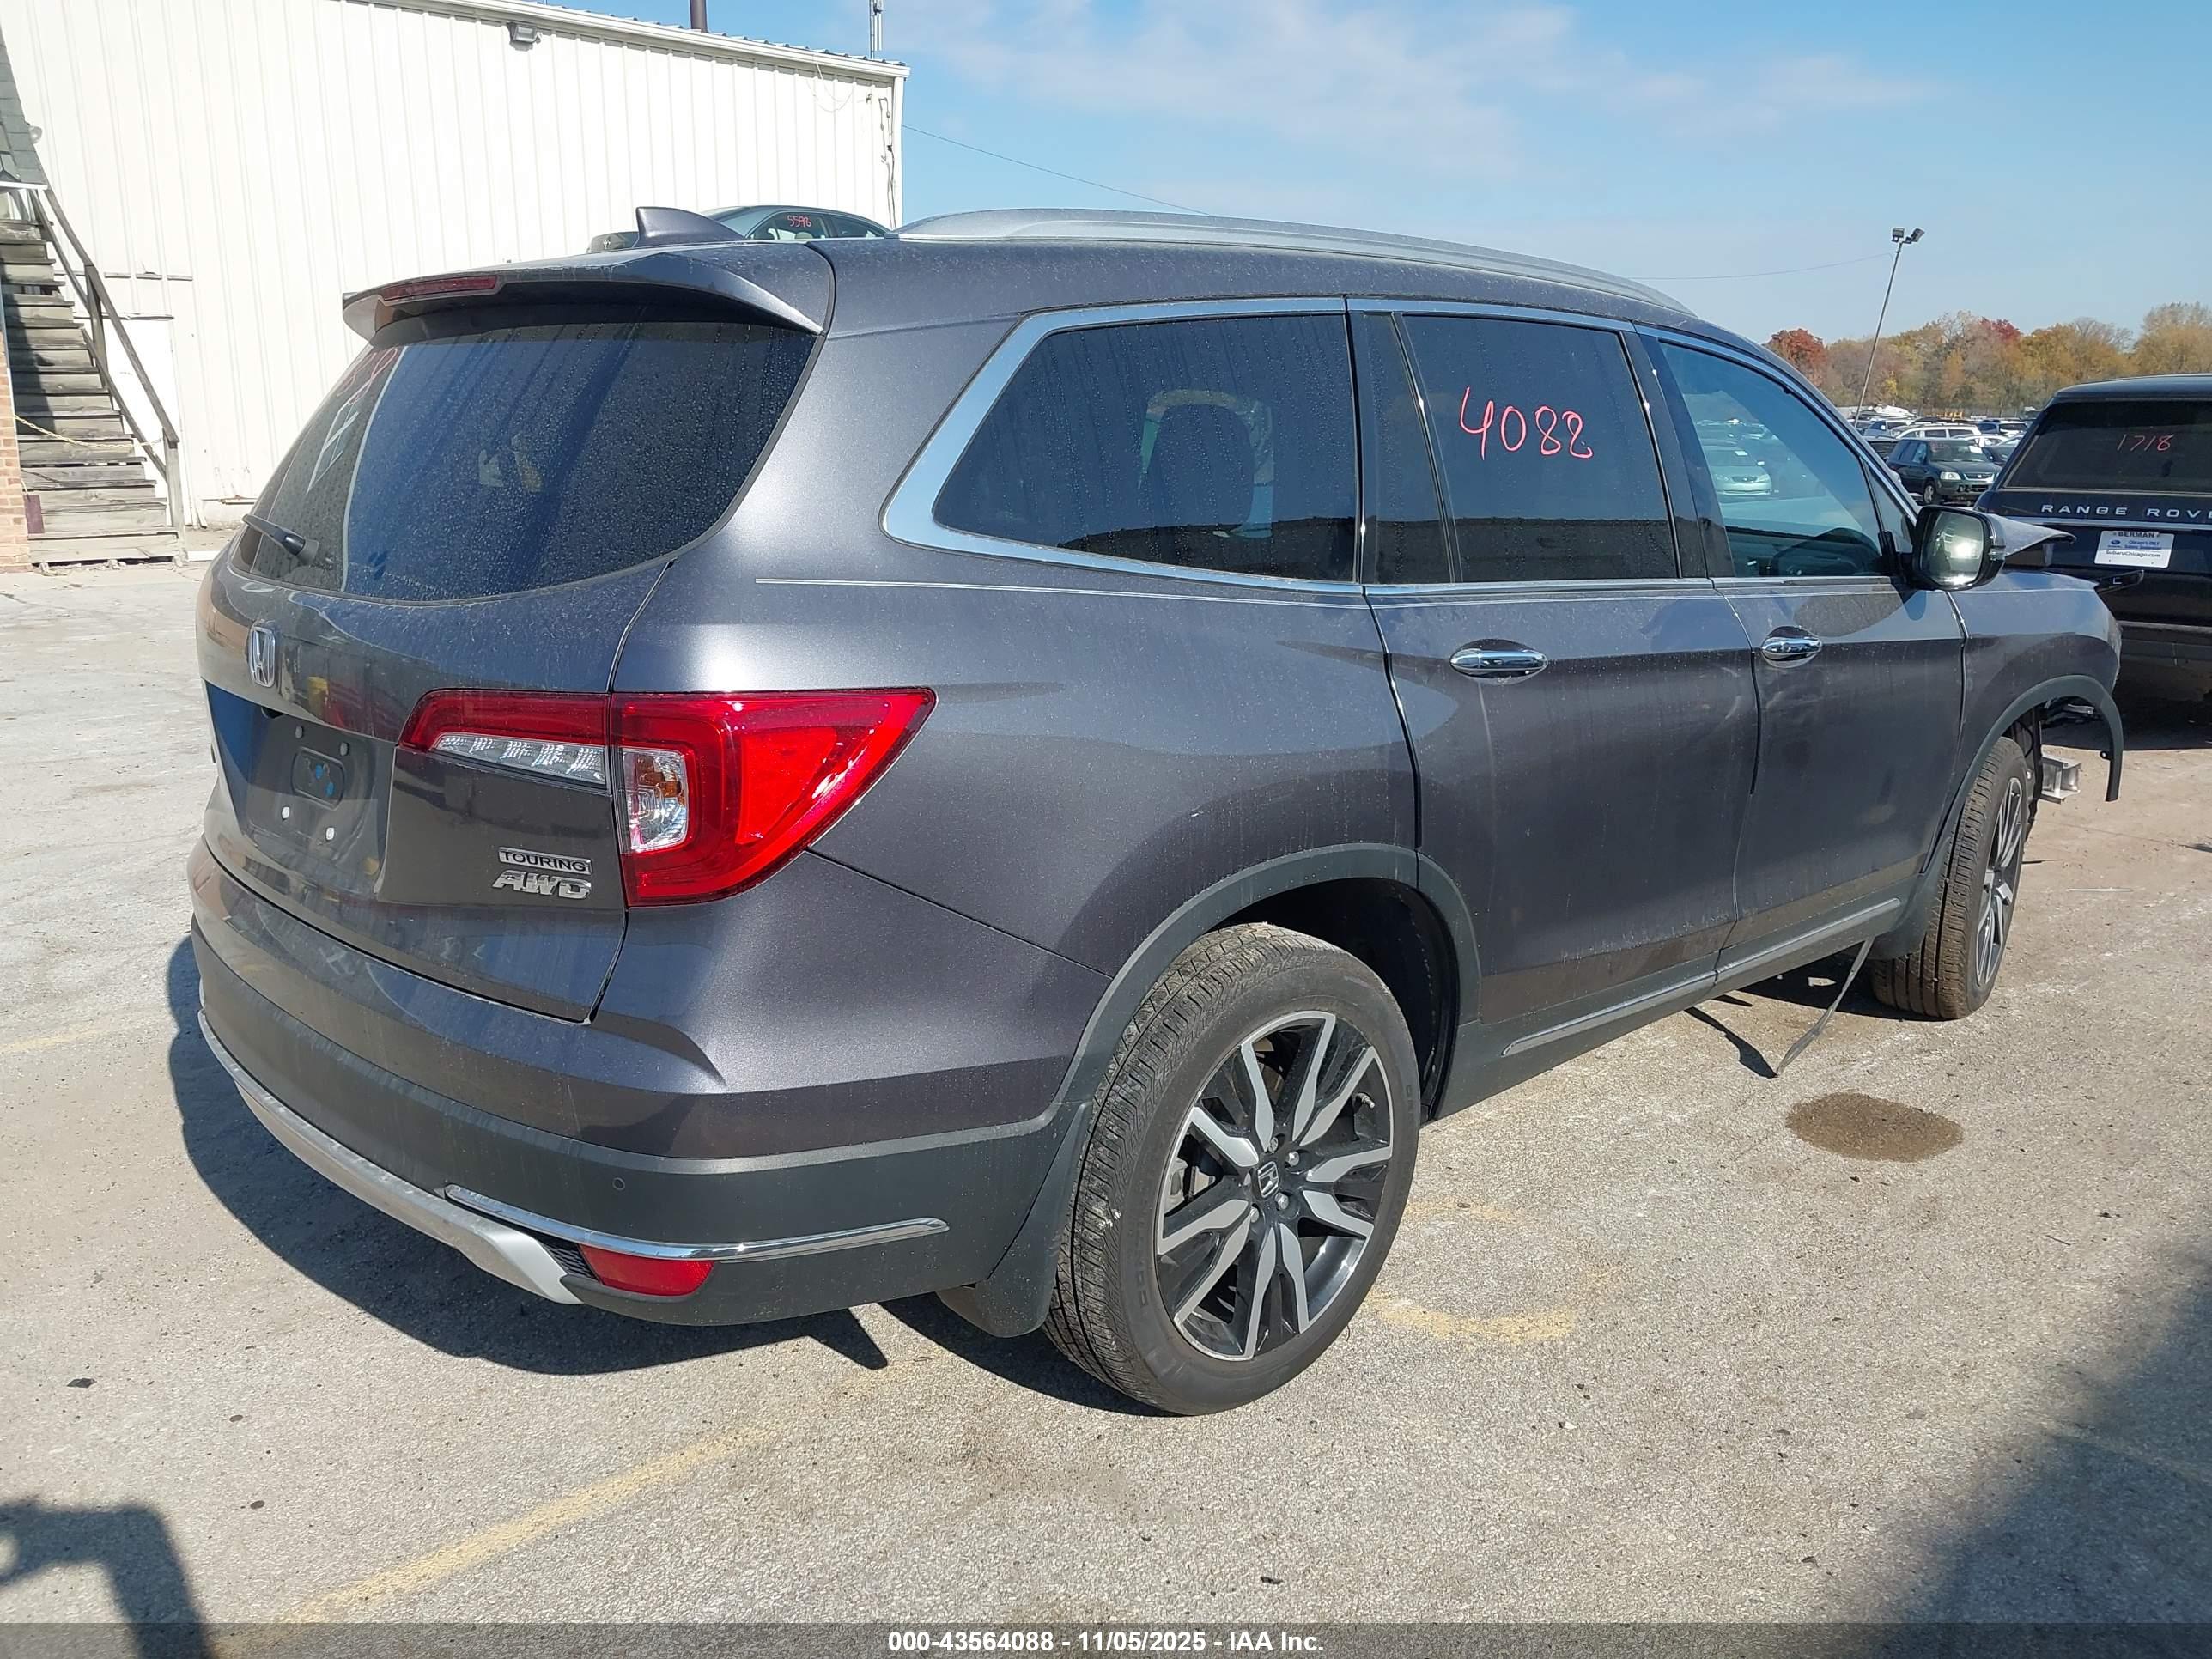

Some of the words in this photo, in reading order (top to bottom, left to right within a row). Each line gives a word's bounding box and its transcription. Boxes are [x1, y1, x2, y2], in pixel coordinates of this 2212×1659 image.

[2117, 434, 2175, 452] 1718
[2040, 504, 2128, 516] RANGE
[502, 851, 587, 872] TOURING
[491, 869, 592, 899] AWD
